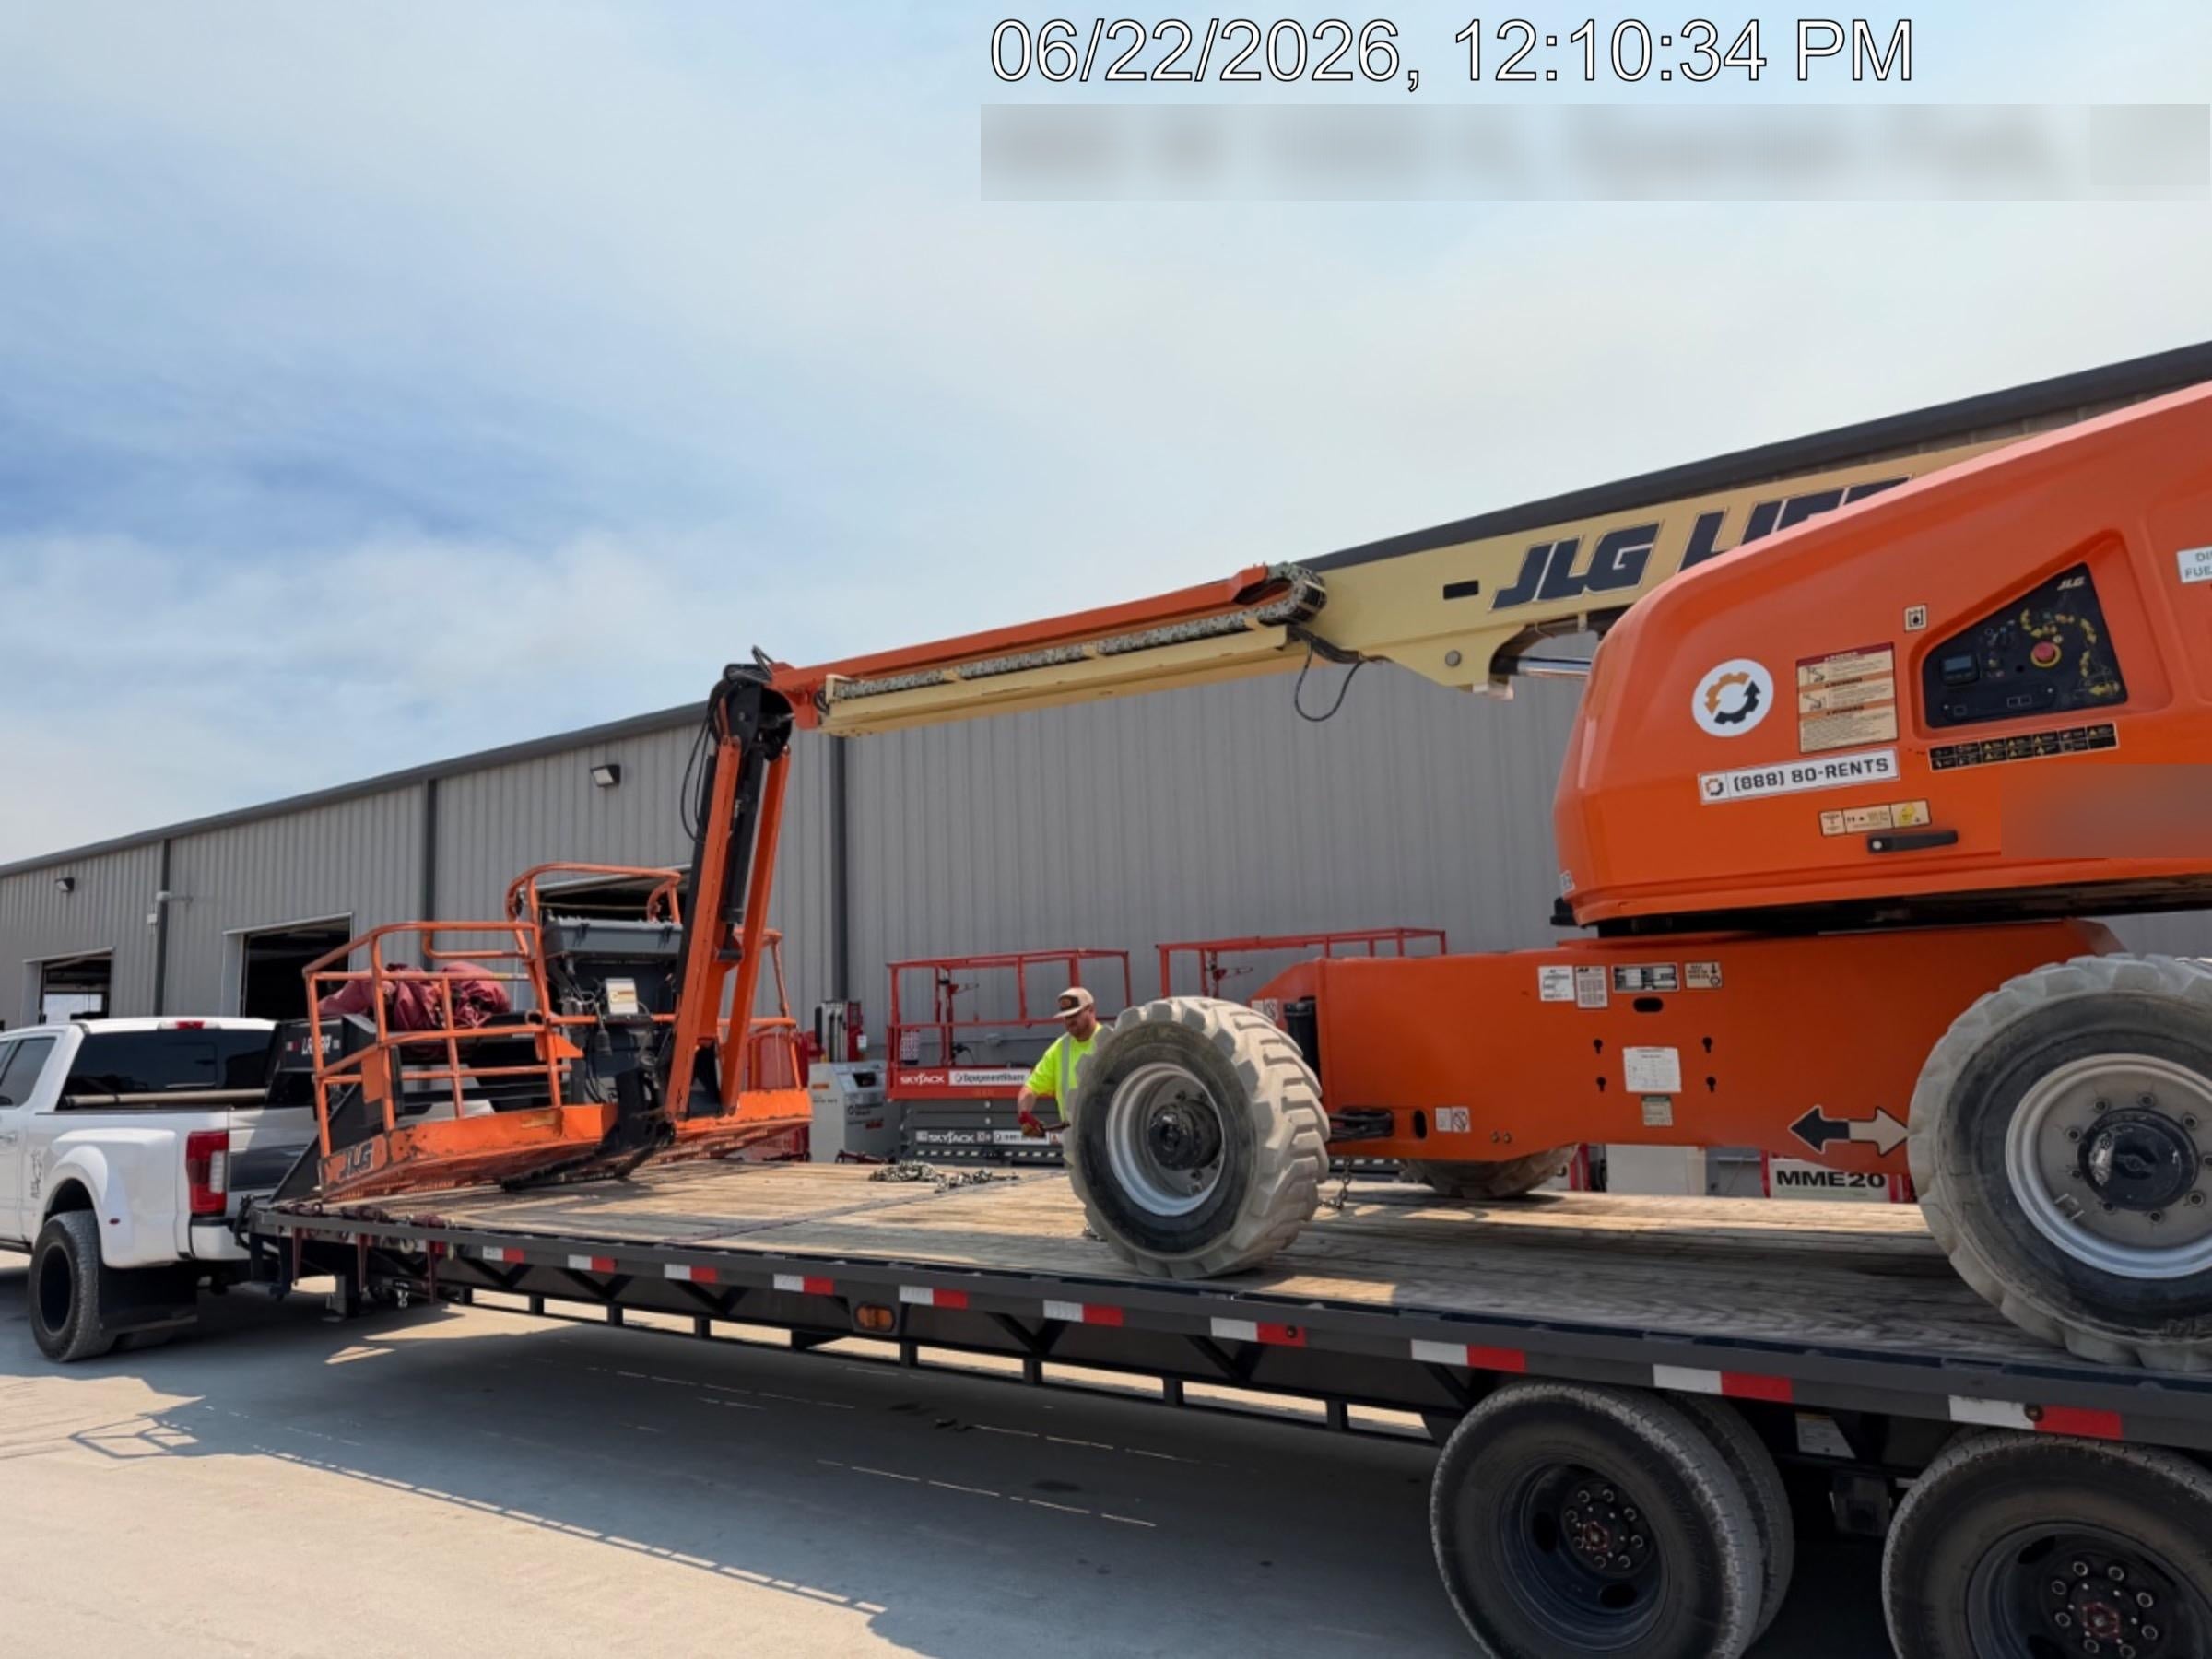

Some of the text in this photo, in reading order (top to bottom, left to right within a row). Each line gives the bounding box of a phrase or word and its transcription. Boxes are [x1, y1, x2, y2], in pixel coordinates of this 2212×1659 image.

[1490, 476, 1912, 610] JLG LI
[2195, 550, 2212, 562] DI
[1733, 757, 1889, 792] (888) 80-RENTS
[900, 1072, 945, 1086] SKYJACK
[339, 1143, 374, 1180] JLG
[1776, 1170, 1886, 1188] MME20
